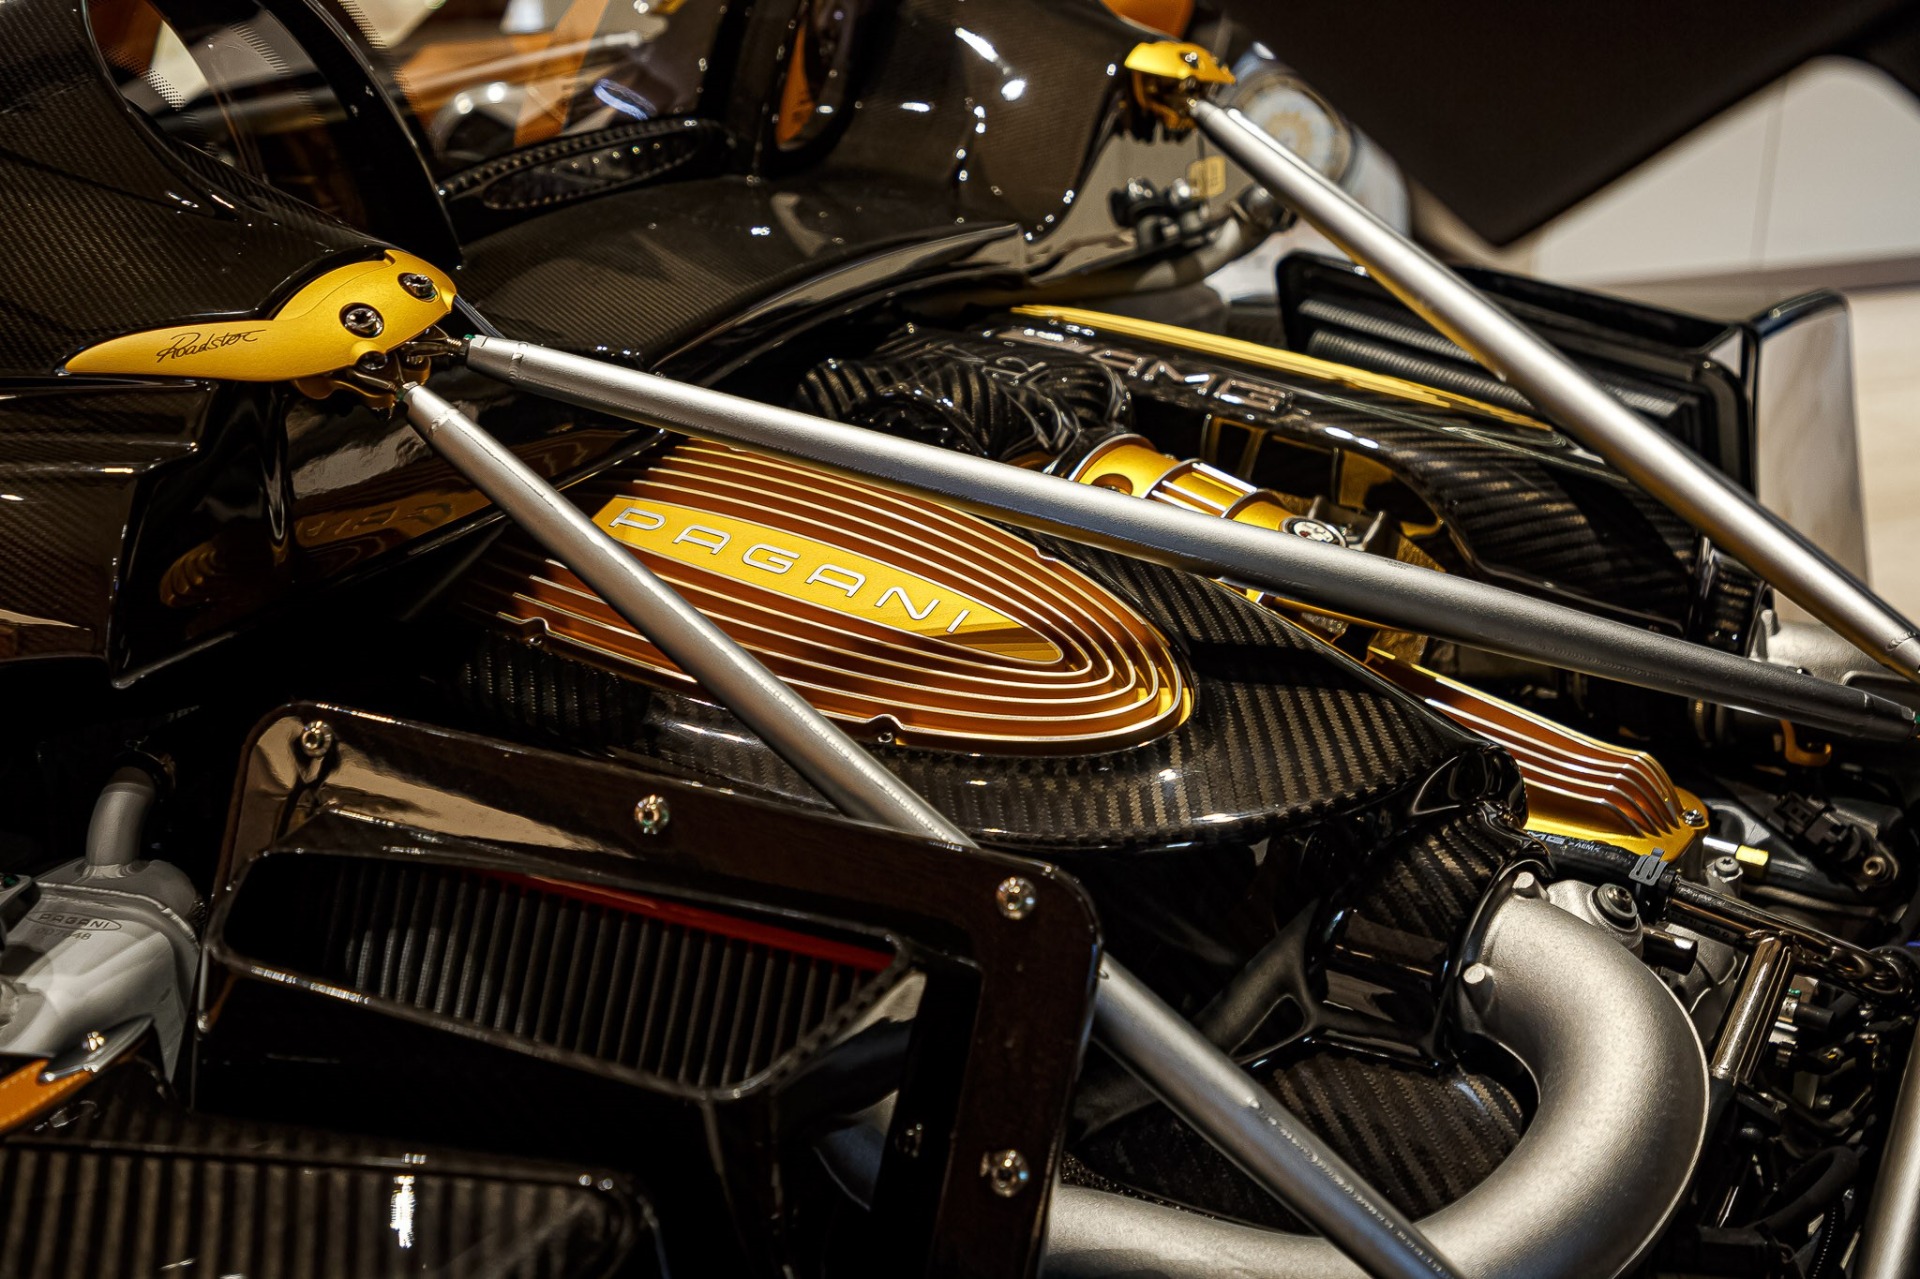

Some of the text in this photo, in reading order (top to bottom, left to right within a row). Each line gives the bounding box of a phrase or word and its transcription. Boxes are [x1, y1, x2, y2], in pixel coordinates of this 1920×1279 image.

[156, 329, 267, 363] Roadster
[608, 506, 971, 634] PAGANI
[39, 913, 110, 929] PAGANI
